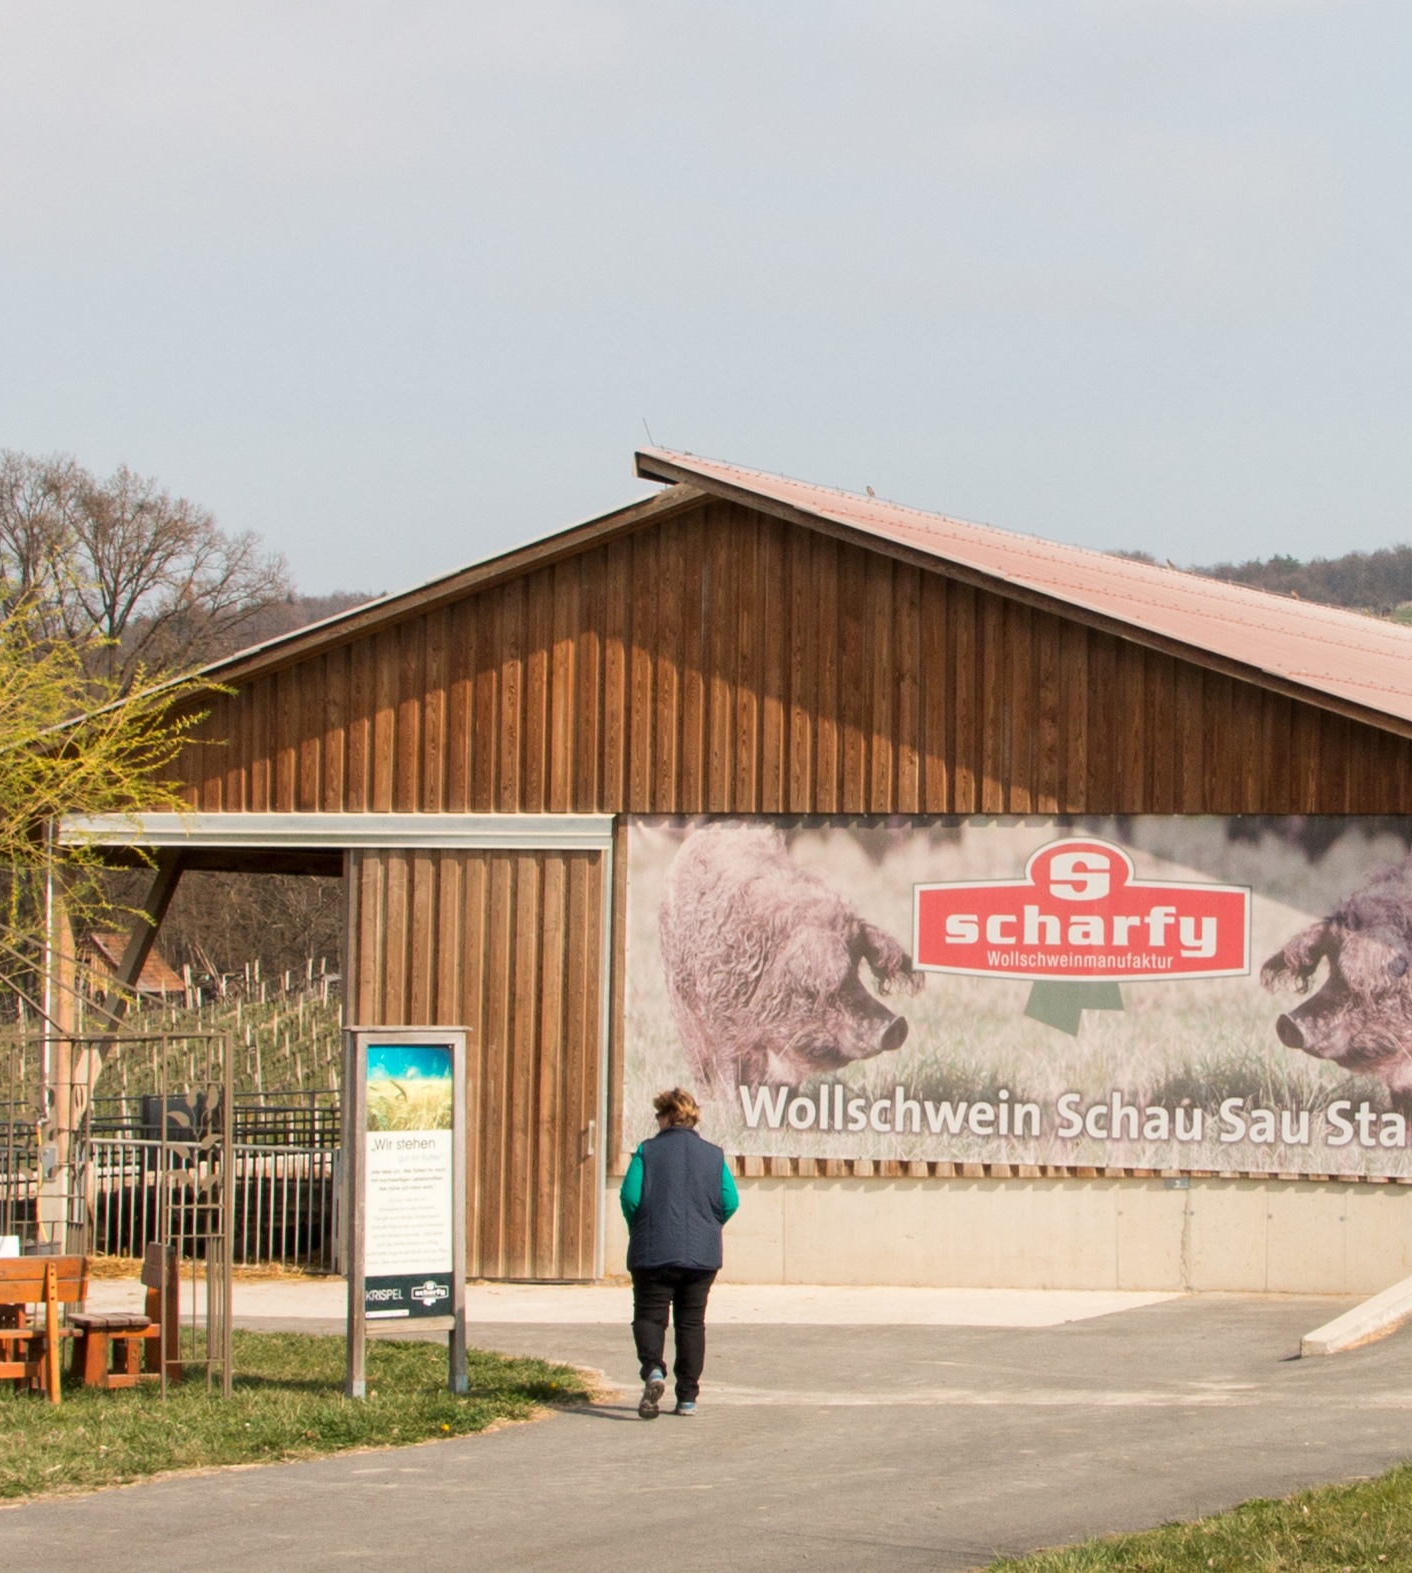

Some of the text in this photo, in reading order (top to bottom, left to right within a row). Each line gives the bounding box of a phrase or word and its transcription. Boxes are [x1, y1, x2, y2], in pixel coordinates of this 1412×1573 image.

[1049, 851, 1111, 901] S
[944, 904, 1218, 958] scharfy
[987, 950, 1174, 970] Wollschweinmanufaktur
[738, 1083, 1041, 1137] Wollschwein
[1056, 1091, 1203, 1142] Schau
[1218, 1097, 1310, 1145] Sau
[396, 1137, 436, 1150] stehen
[365, 1288, 404, 1301] KRISPEL
